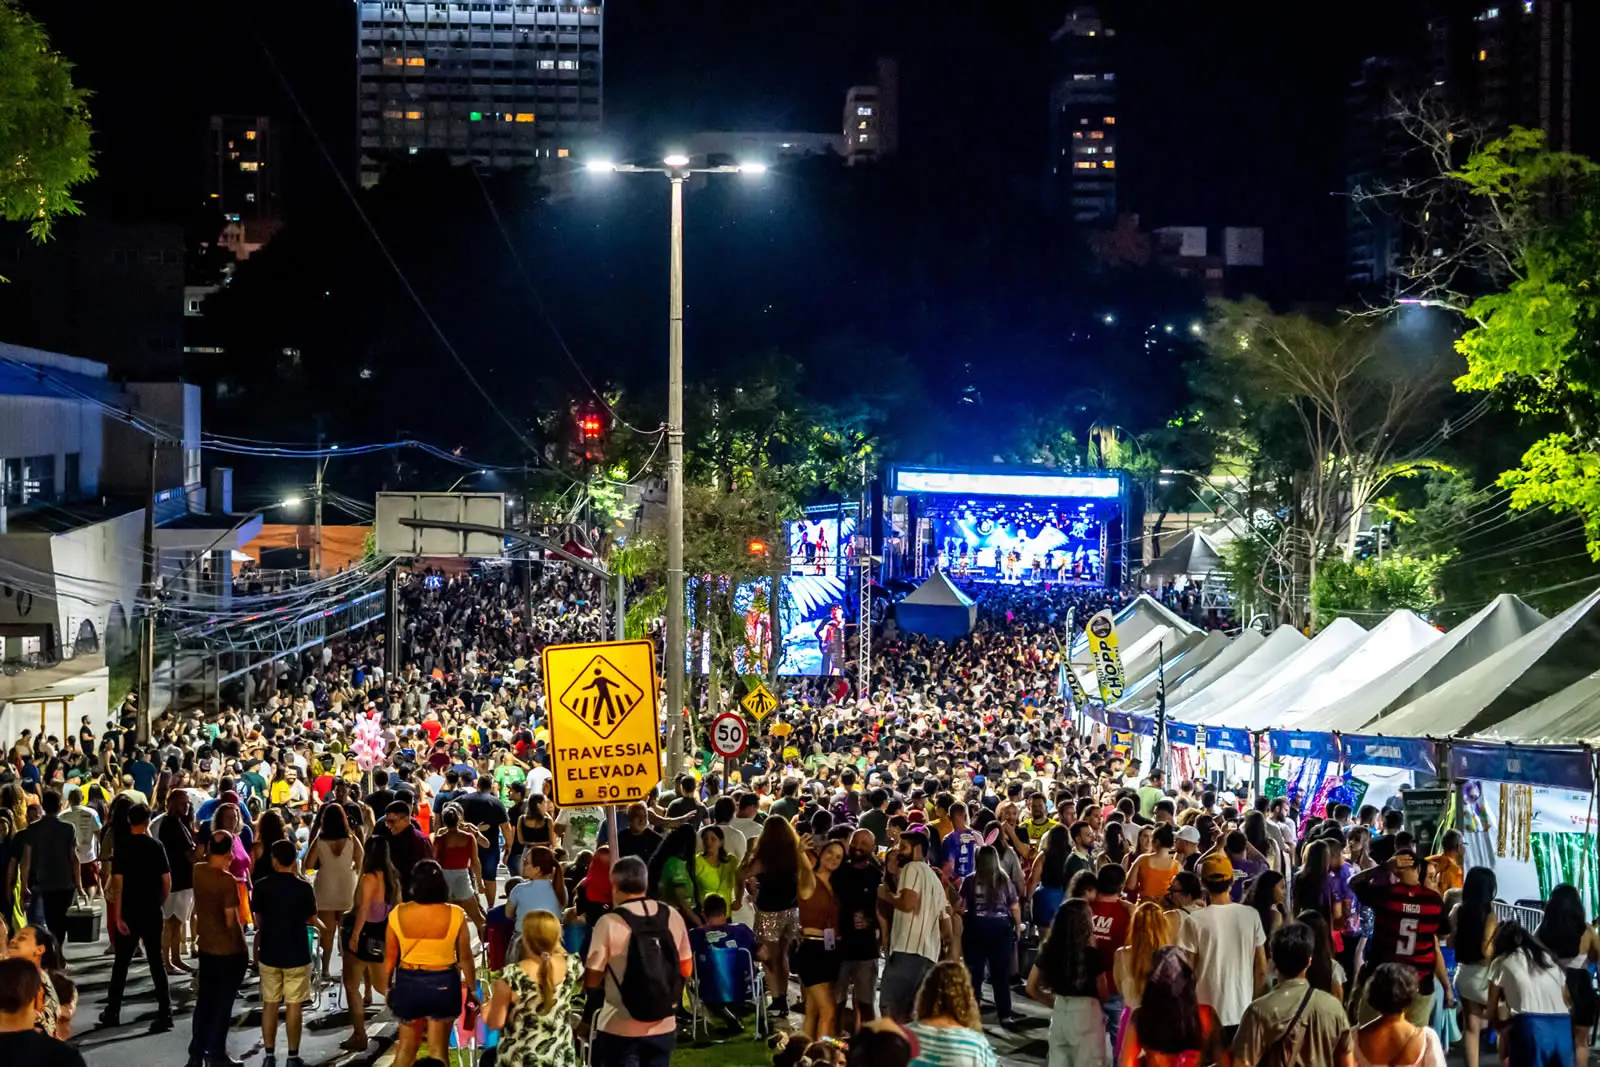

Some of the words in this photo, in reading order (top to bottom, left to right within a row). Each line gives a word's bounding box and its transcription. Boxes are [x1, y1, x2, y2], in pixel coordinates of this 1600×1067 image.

[1097, 668, 1108, 686] AQUI
[1099, 640, 1124, 699] CHOPP
[718, 725, 741, 743] 50
[558, 742, 654, 761] TRAVESSIA
[567, 763, 647, 781] ELEVADA
[575, 788, 584, 799] a
[598, 785, 620, 799] 50
[627, 787, 642, 797] m
[1402, 903, 1420, 914] TIAGO
[1395, 918, 1419, 956] 5
